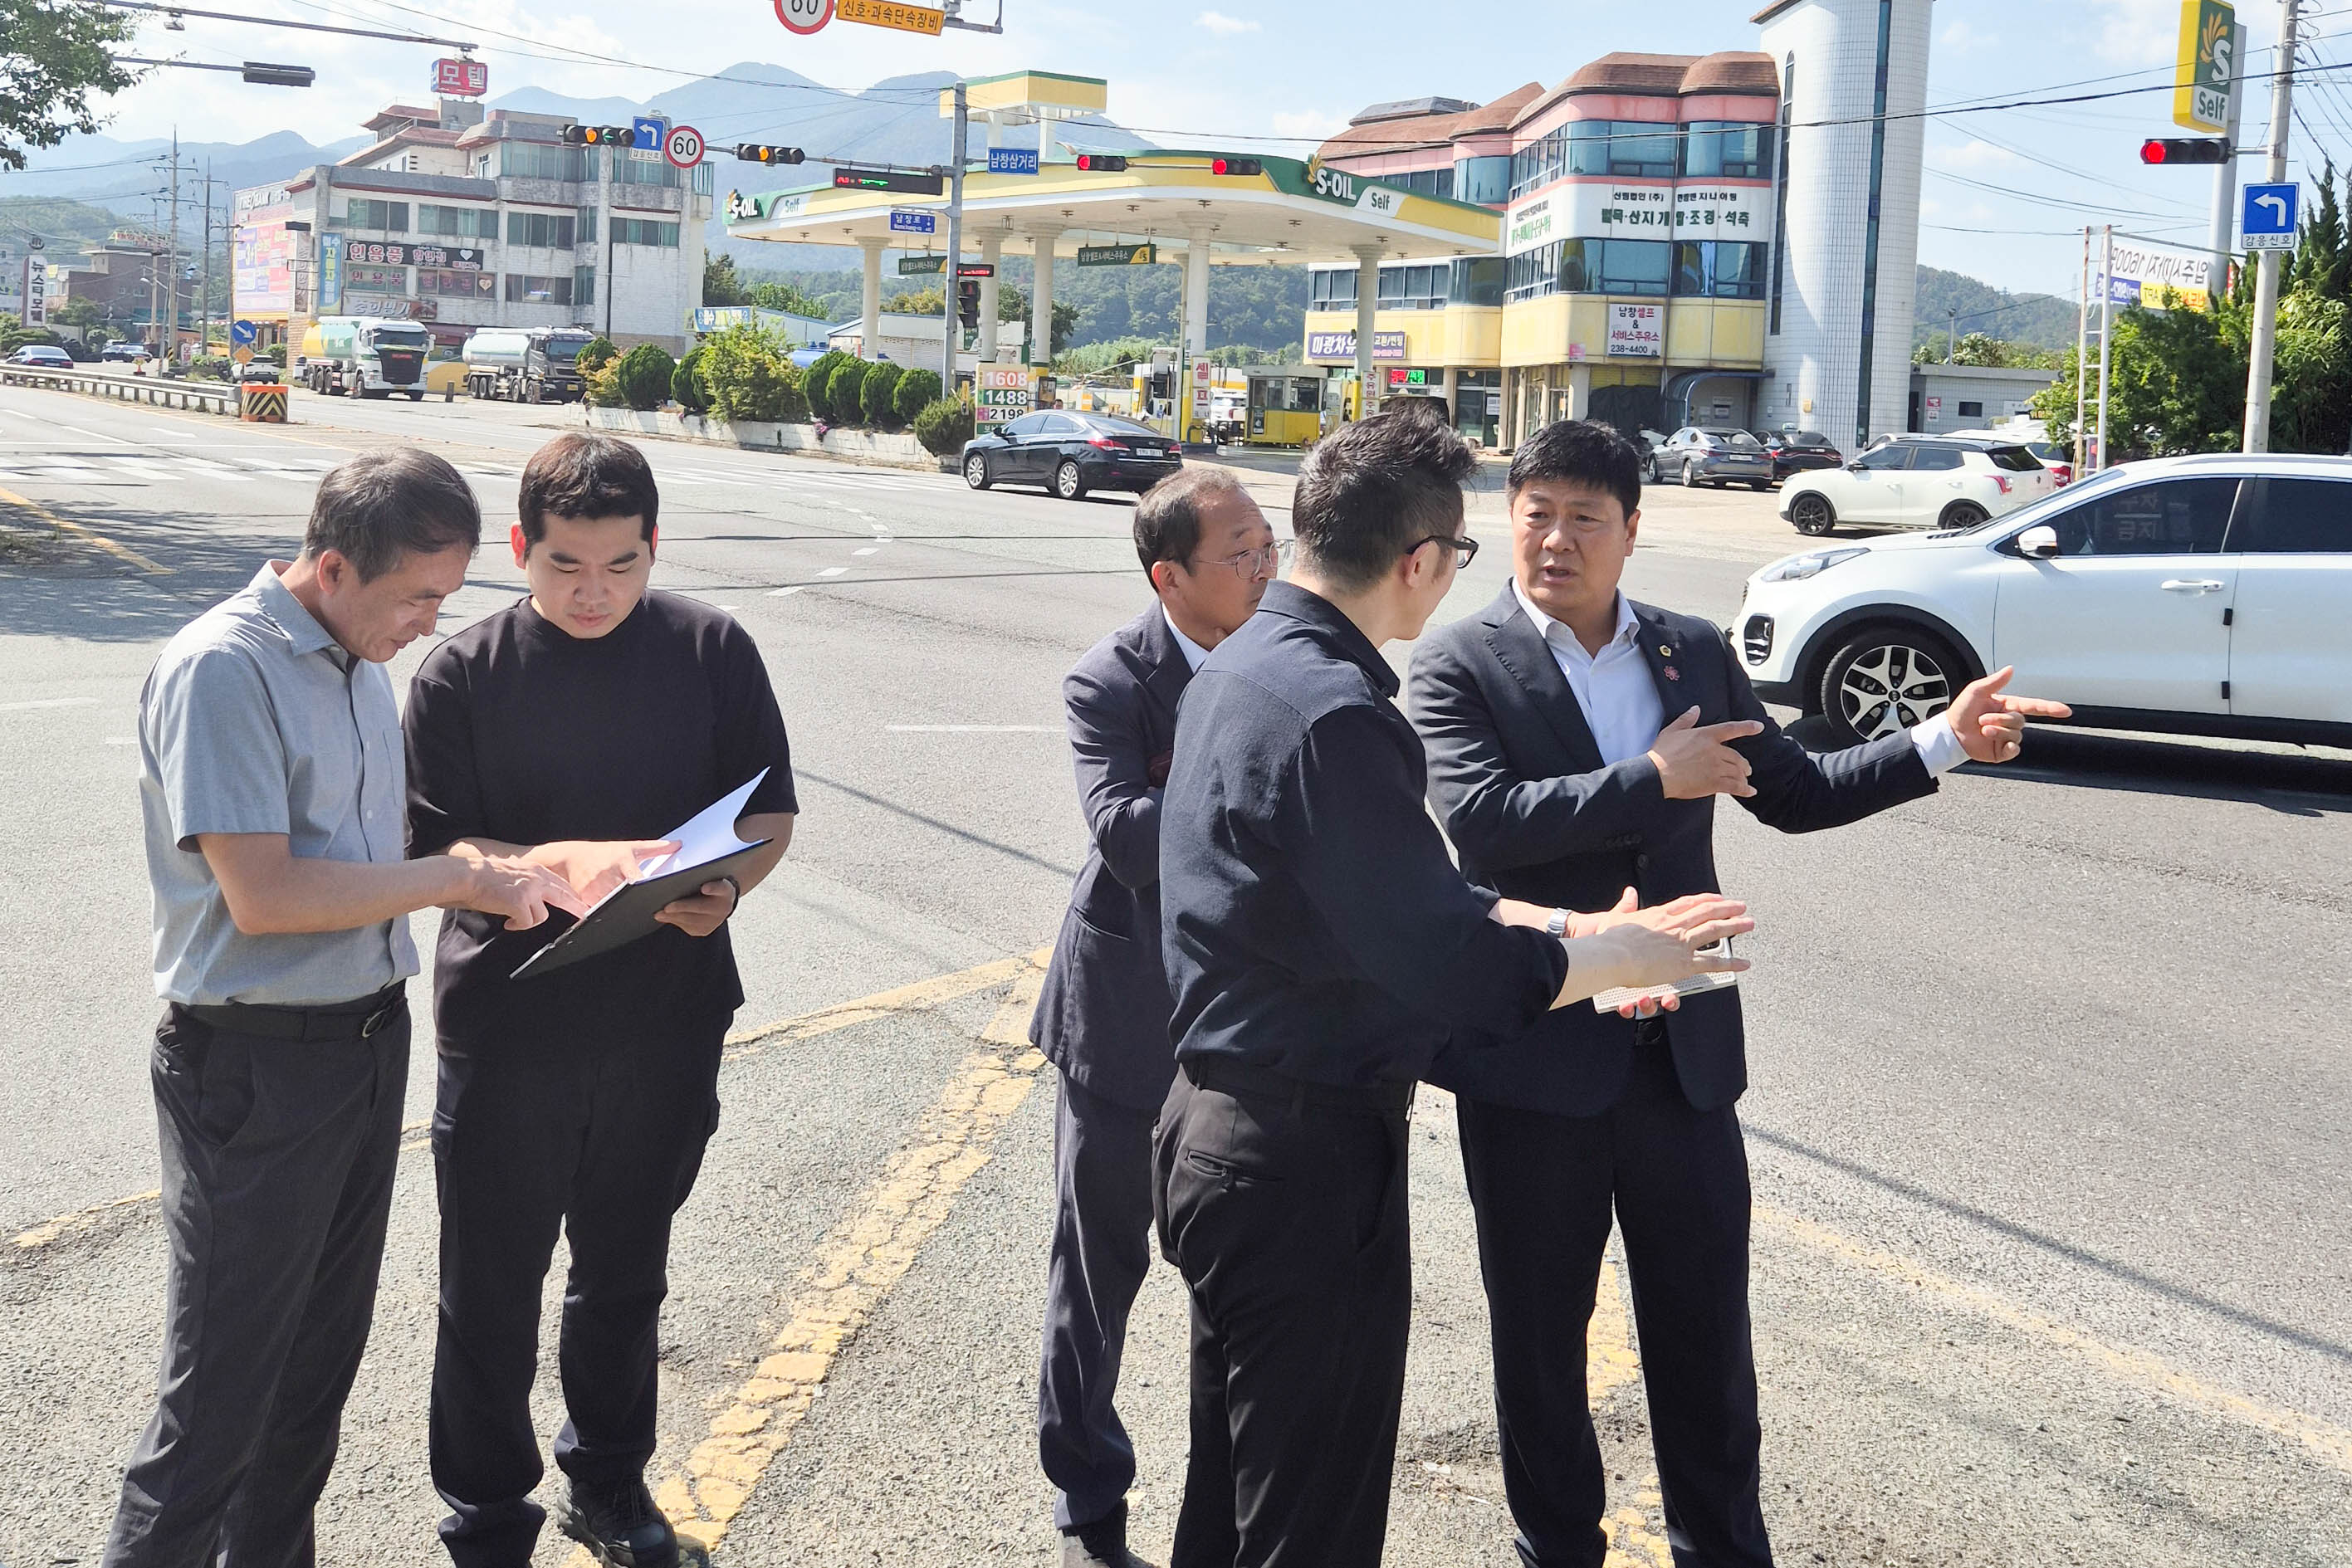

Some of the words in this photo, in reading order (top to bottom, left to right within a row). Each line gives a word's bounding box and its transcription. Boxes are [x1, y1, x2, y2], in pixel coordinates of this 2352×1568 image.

[843, 1, 938, 31] 신호·과속단속장비
[441, 65, 485, 88] 모텔
[2198, 91, 2225, 120] Self
[673, 136, 697, 156] 60
[990, 153, 1037, 170] 남창삼거리
[1316, 169, 1357, 200] S-OIL
[731, 198, 758, 220] S-OIL
[785, 198, 799, 213] Self
[1372, 193, 1390, 210] Self
[2245, 236, 2291, 247] 감응신호
[32, 261, 46, 322] 뉴스타모텔
[1619, 307, 1655, 318] 남창셀프
[1633, 320, 1639, 329] &
[1612, 330, 1660, 342] 서비스주유소
[1611, 345, 1648, 354] 238-4400
[987, 372, 1027, 387] 1608
[986, 390, 1027, 405] 1488
